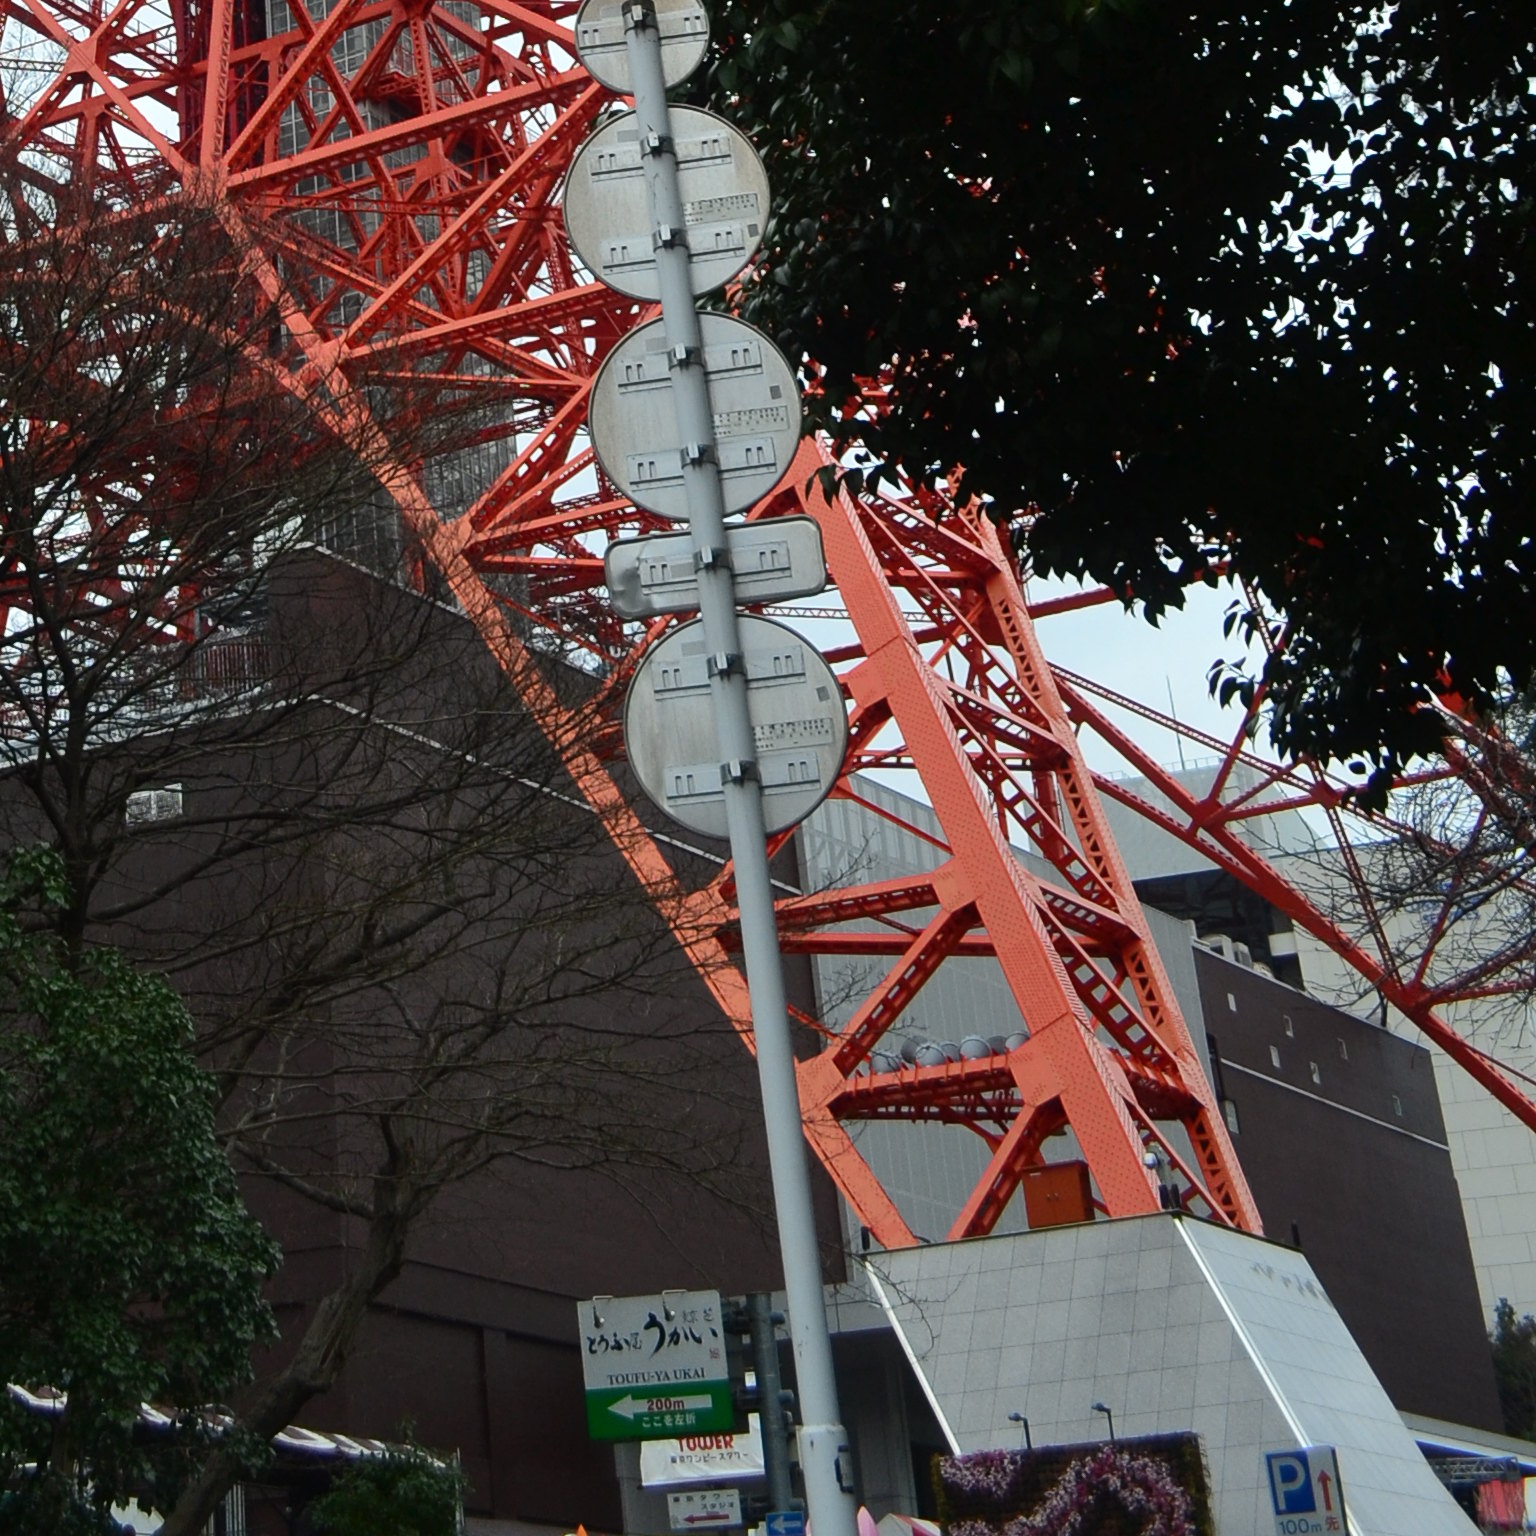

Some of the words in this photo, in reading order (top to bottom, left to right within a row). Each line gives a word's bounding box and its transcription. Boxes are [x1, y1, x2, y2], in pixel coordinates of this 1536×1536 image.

[607, 1370, 670, 1386] TOUFU-YA
[673, 1367, 706, 1381] UKAI
[646, 1397, 685, 1412] 200m
[642, 1412, 696, 1428] ここを左折
[677, 1434, 734, 1452] TOWER
[1271, 1455, 1306, 1511] P
[1279, 1518, 1322, 1535] 100m
[1325, 1516, 1340, 1532] 先
